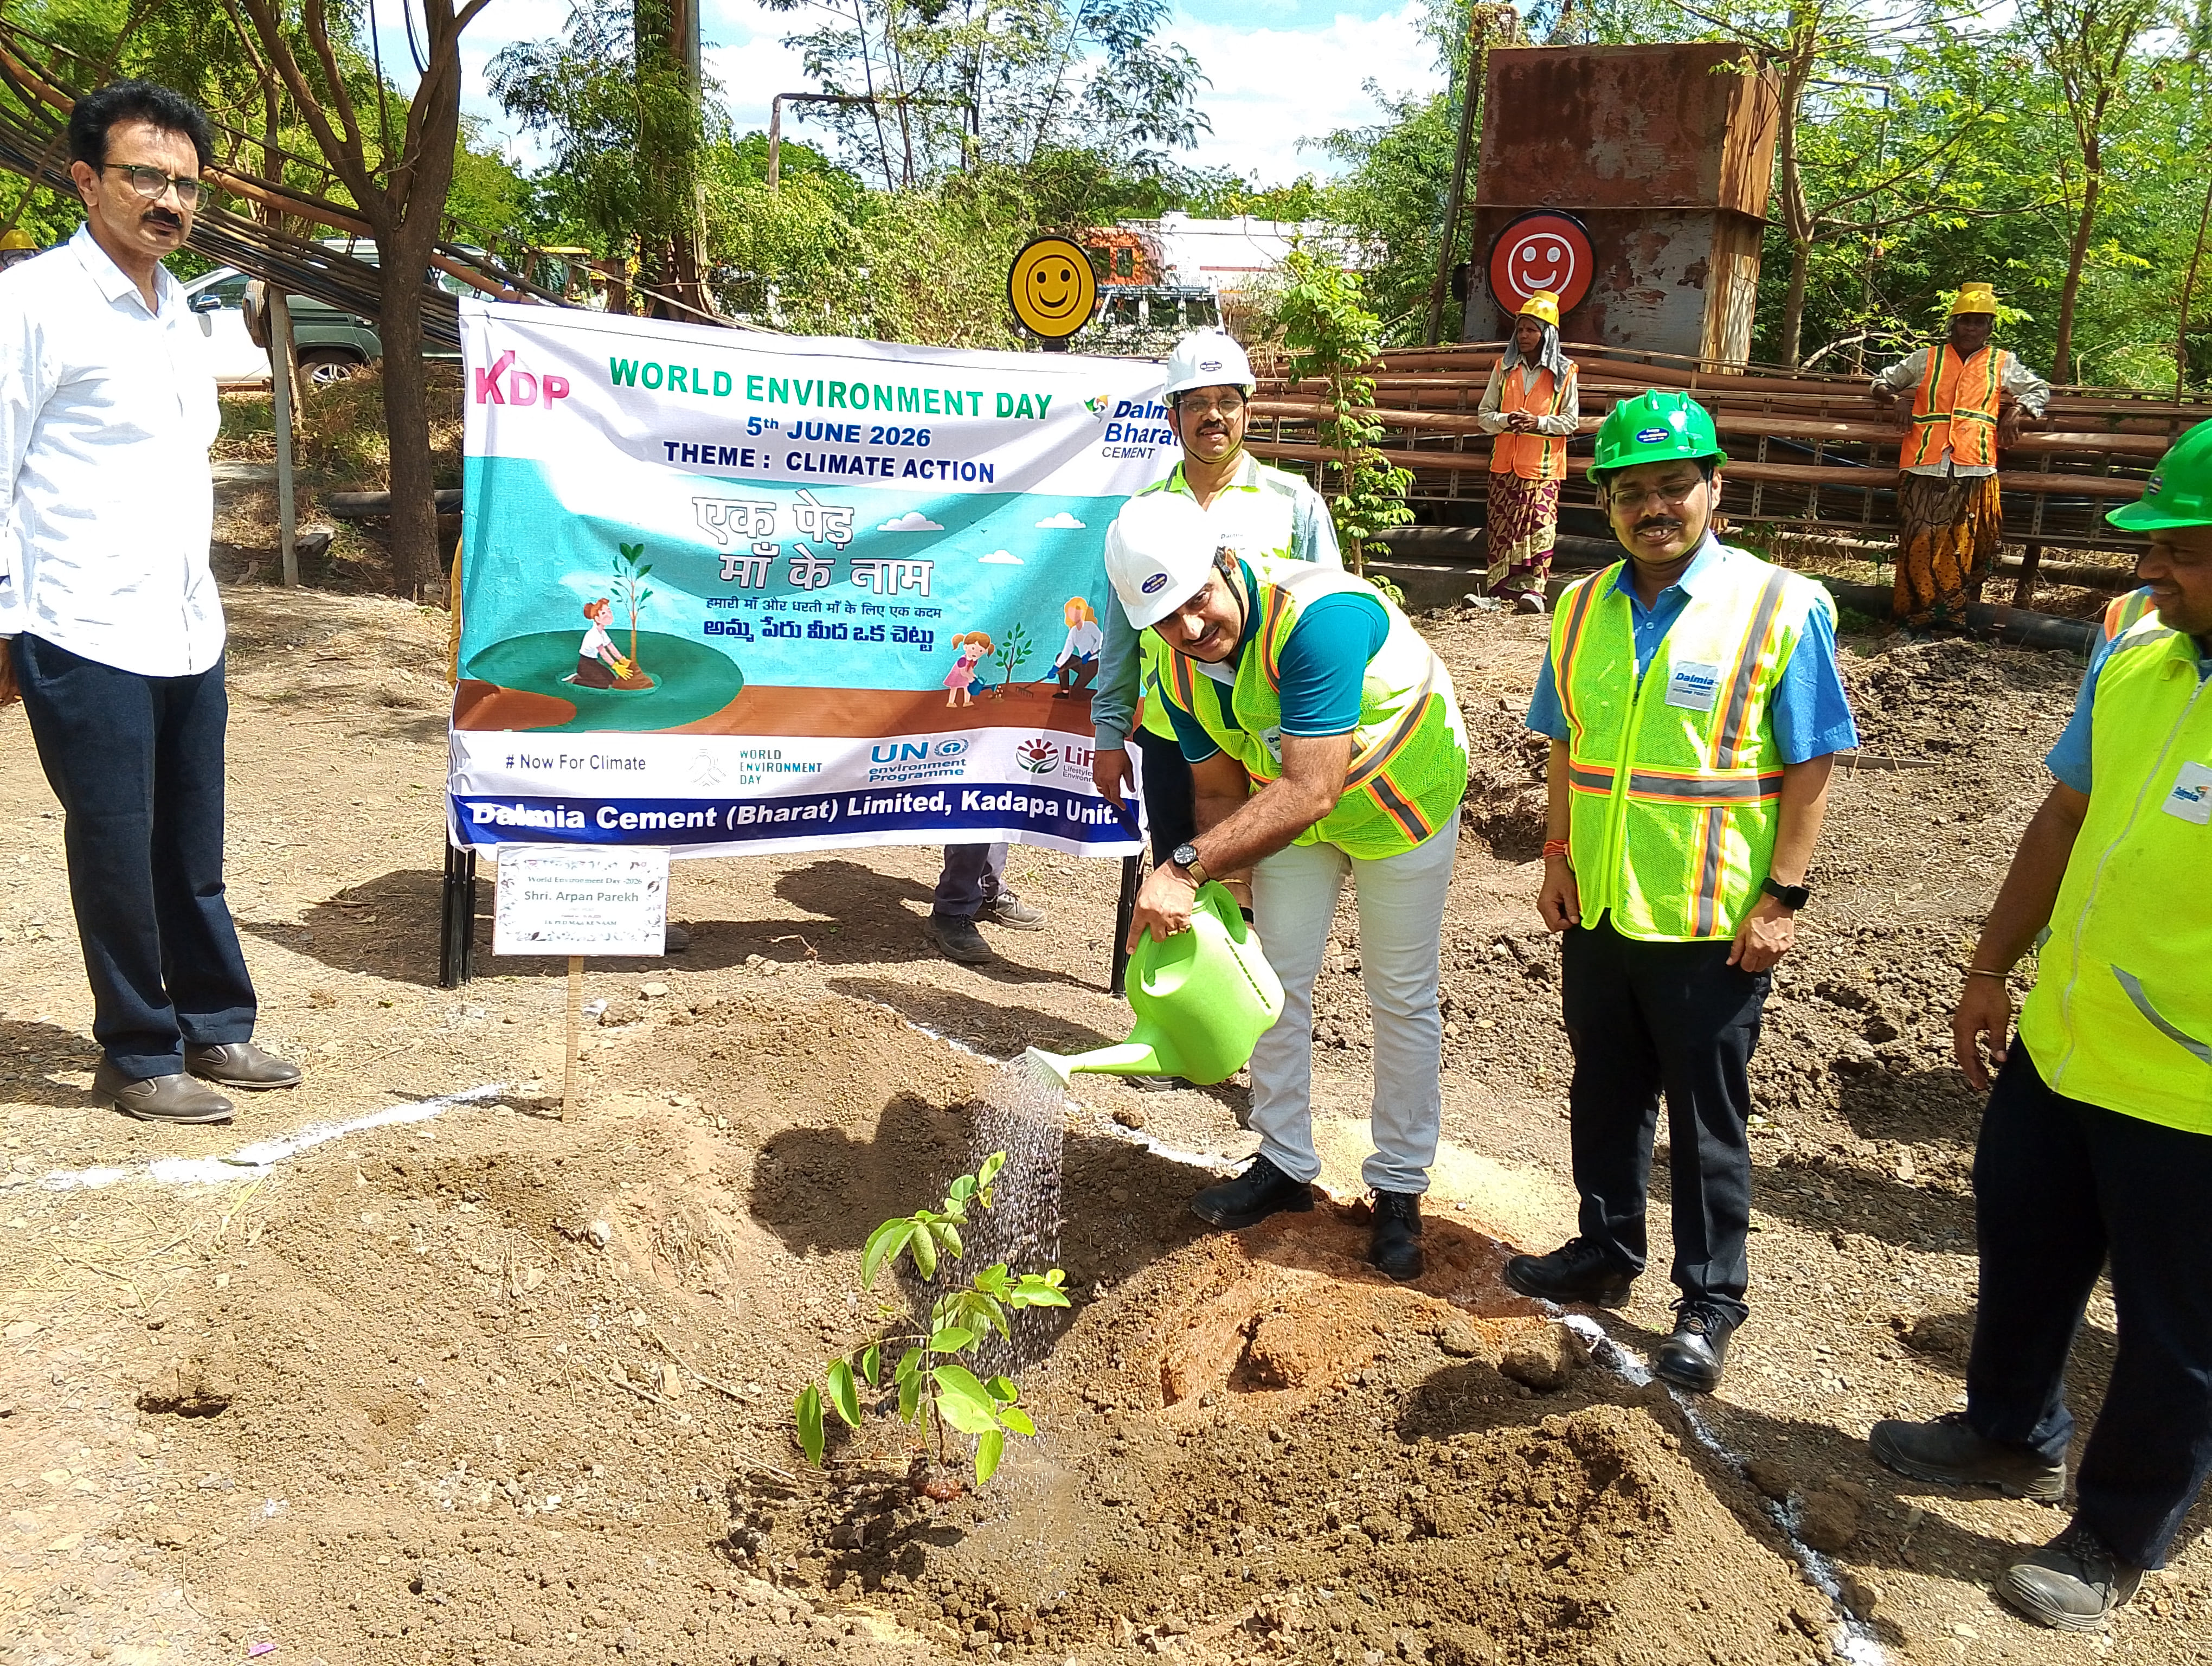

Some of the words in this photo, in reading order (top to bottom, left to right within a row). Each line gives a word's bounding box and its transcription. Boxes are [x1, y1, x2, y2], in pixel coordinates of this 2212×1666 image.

[475, 350, 569, 409] KDP
[610, 357, 731, 396] WORLD
[747, 375, 982, 417] ENVIRONMENT
[996, 393, 1052, 420] DAY
[1113, 401, 1168, 420] Dalm
[747, 416, 779, 437] 5th
[786, 420, 861, 443] JUNE
[870, 427, 931, 447] 2026
[1102, 447, 1155, 459] CEMENT
[786, 451, 896, 477] CLIMATE
[903, 460, 994, 484] ACTION
[692, 497, 776, 545] एक
[793, 489, 854, 550] पेड़
[719, 542, 780, 588] माँ
[788, 543, 835, 590] के
[851, 559, 934, 596] नाम
[706, 595, 738, 608] हमारी
[744, 597, 760, 609] माँ
[762, 597, 787, 611] और
[793, 600, 822, 612] धरती
[826, 600, 841, 613] माँ
[845, 600, 857, 614] के
[861, 603, 885, 617] लिए
[890, 606, 910, 618] एक
[914, 607, 942, 618] कदम
[704, 618, 754, 642] అమ్మ
[760, 616, 801, 638] పేరు
[808, 620, 847, 640] మీద
[853, 625, 885, 642] ఒక
[891, 625, 934, 651] చెట్టు
[1675, 673, 1714, 685] Dalmia
[560, 754, 584, 769] For
[590, 755, 646, 770] Climate
[740, 750, 781, 759] WORLD
[872, 742, 928, 763] UN
[1065, 746, 1096, 767] LiF
[740, 762, 822, 772] ENVIRONMENT
[869, 759, 966, 774] environment
[869, 768, 964, 782] Programme
[740, 775, 761, 784] DAY
[473, 804, 585, 828] Dalmia
[596, 806, 717, 830] Cement
[726, 799, 838, 830] (Bharat)
[847, 791, 952, 816] Limited,
[961, 790, 1058, 817] Kadapa
[1066, 799, 1118, 824] Unit.
[525, 891, 551, 900] Shri.
[556, 892, 593, 902] Arpan
[597, 892, 638, 901] Parekh
